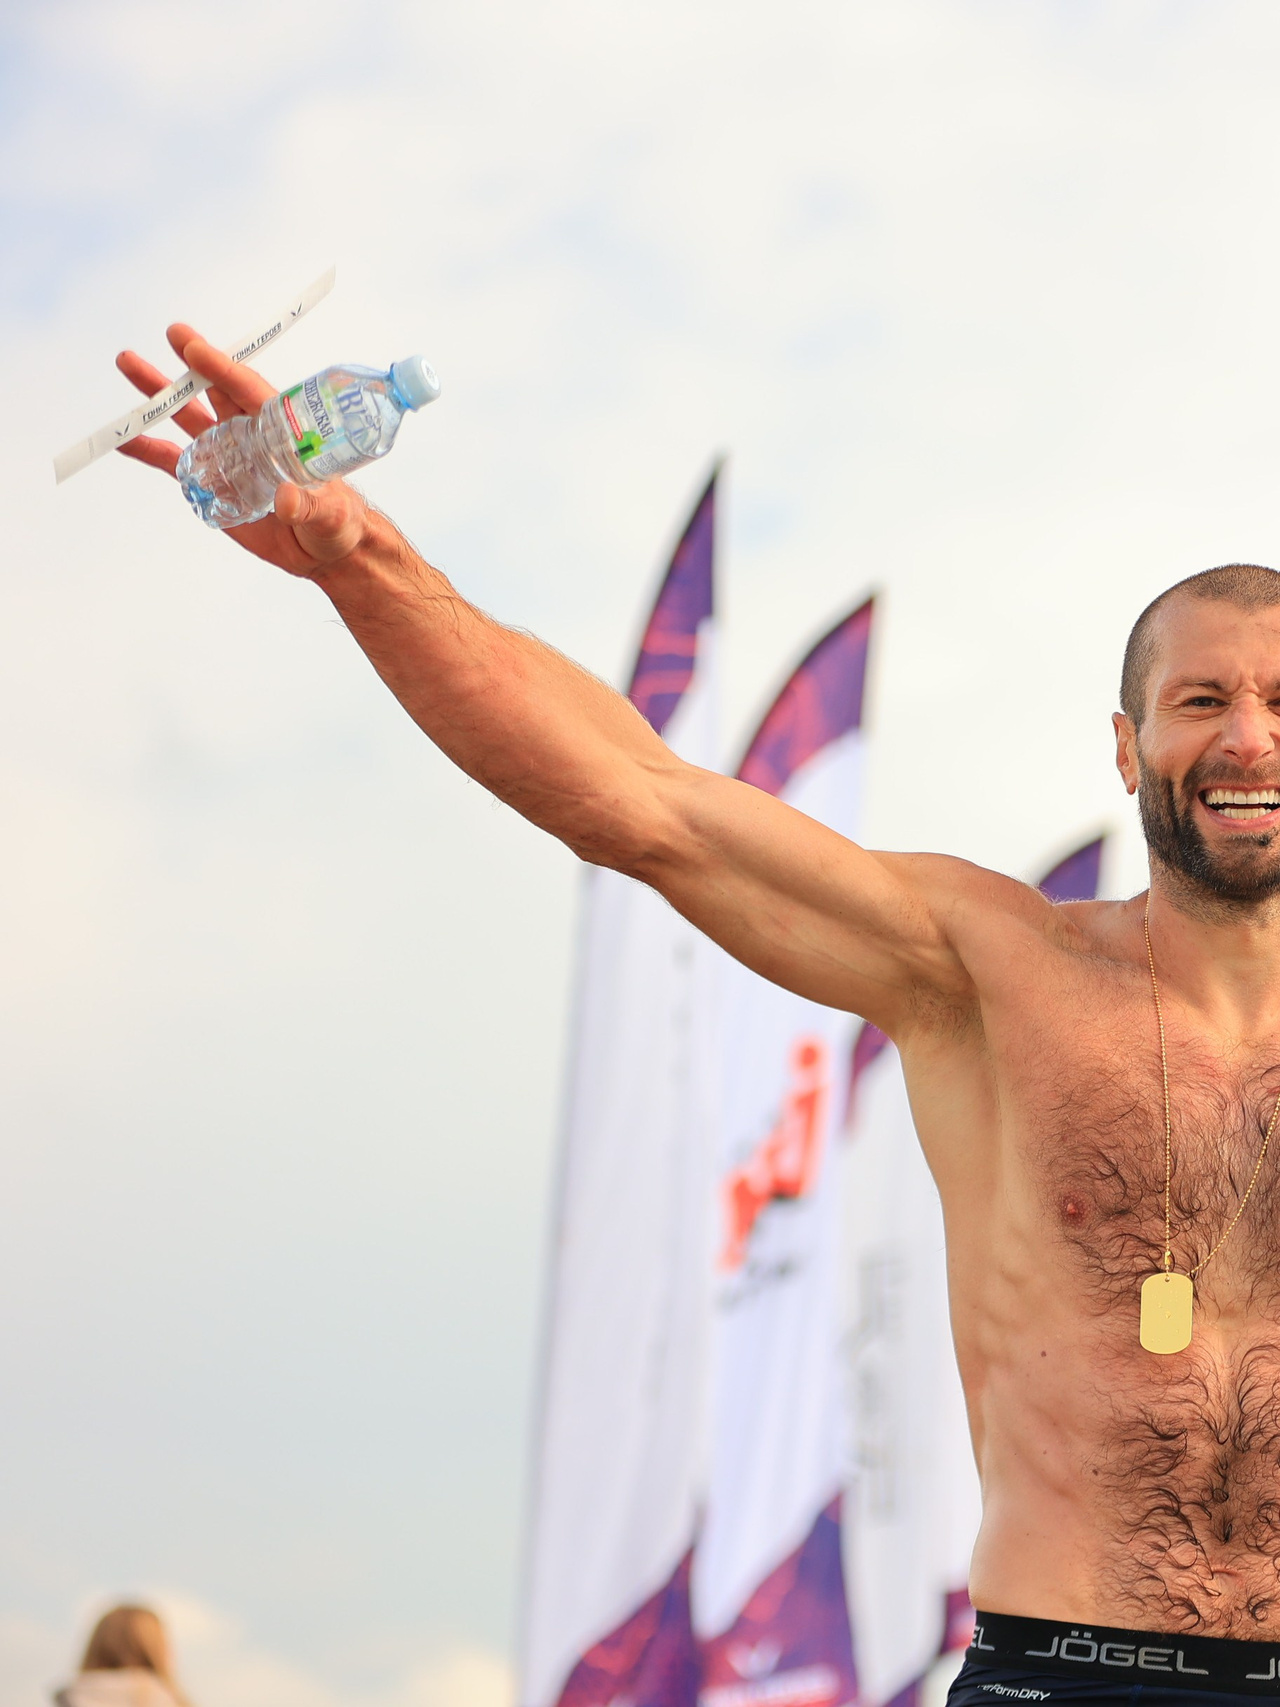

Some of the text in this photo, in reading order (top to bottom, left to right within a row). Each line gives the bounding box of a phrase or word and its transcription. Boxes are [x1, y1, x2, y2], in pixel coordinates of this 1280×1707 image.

[232, 322, 282, 362] ГОНКА ГЕРОЕВ
[143, 381, 194, 422] ГОНКА ГЕРОЕВ
[1025, 1630, 1209, 1675] JÖGEL
